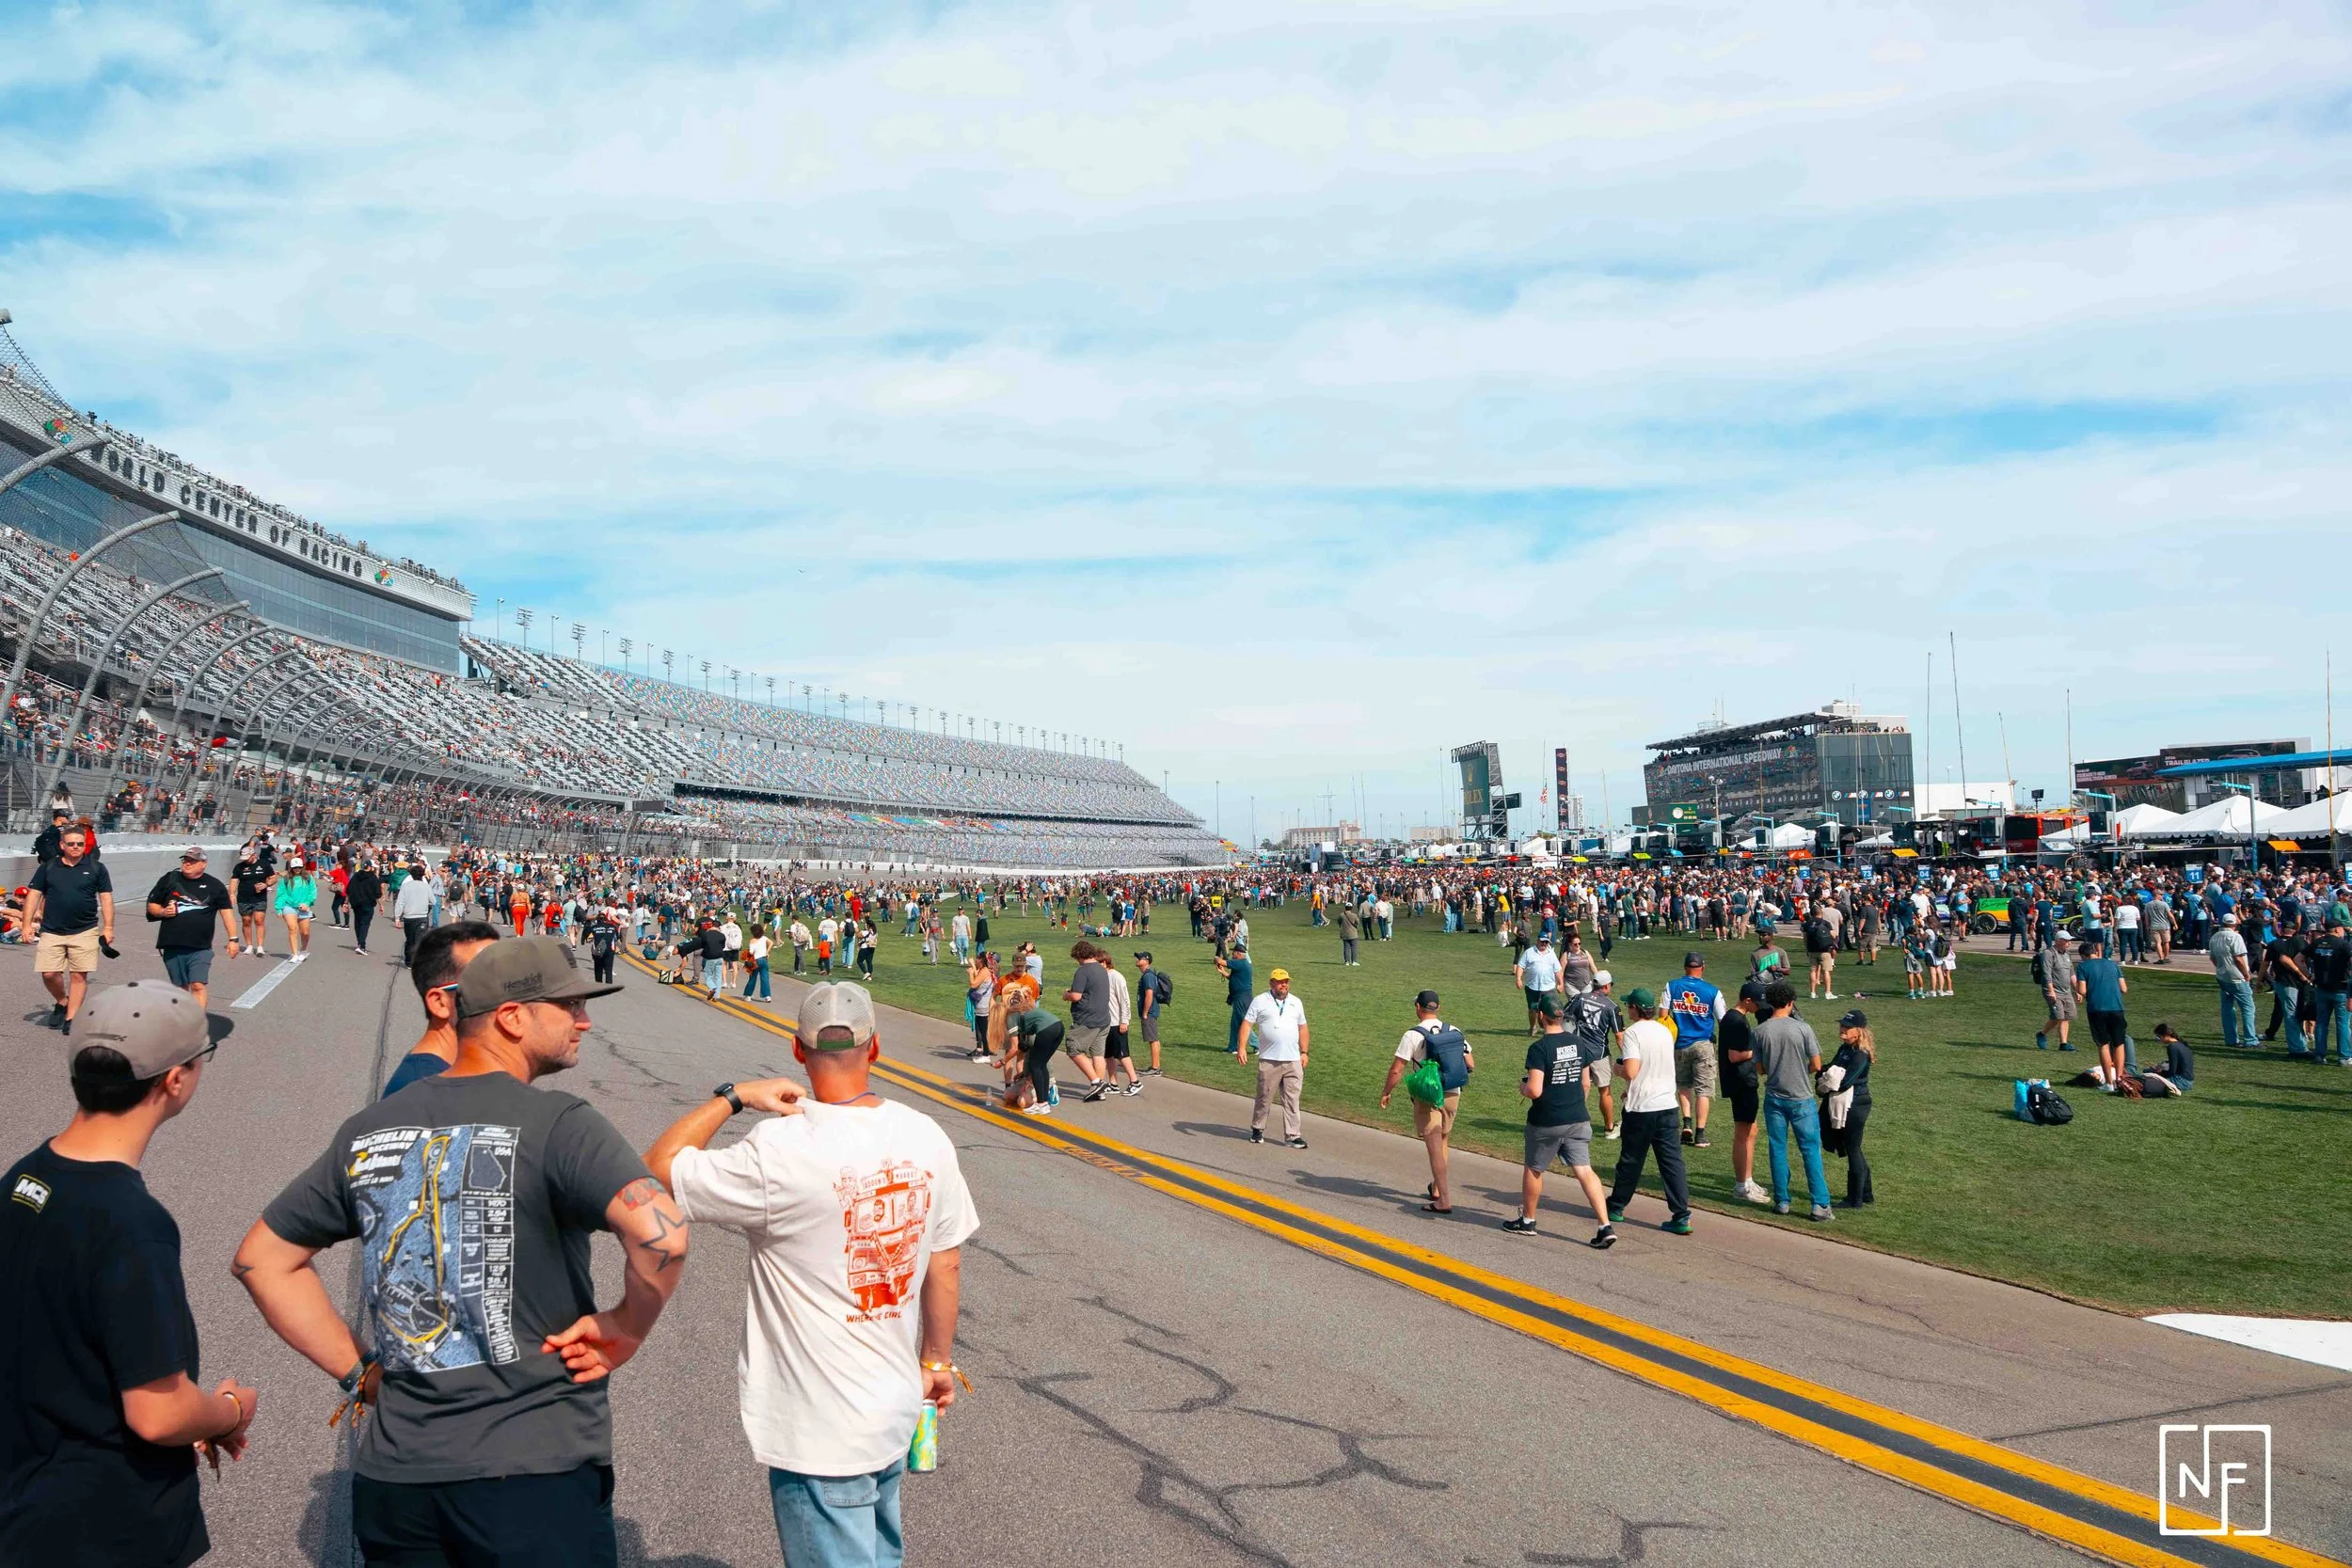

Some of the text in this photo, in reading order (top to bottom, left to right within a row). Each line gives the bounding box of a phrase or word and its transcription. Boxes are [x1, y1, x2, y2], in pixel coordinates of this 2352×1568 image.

[91, 444, 363, 578] WORLD CENTER OF RACING
[1667, 747, 1783, 775] DAYTONA INTERNATIONAL SPEEDWAY
[2165, 757, 2211, 767] TRAILBLAZER
[2189, 871, 2201, 880] 11
[1673, 1001, 1708, 1014] WONDER
[350, 1130, 421, 1152] MICHELIN
[494, 1146, 512, 1157] USA
